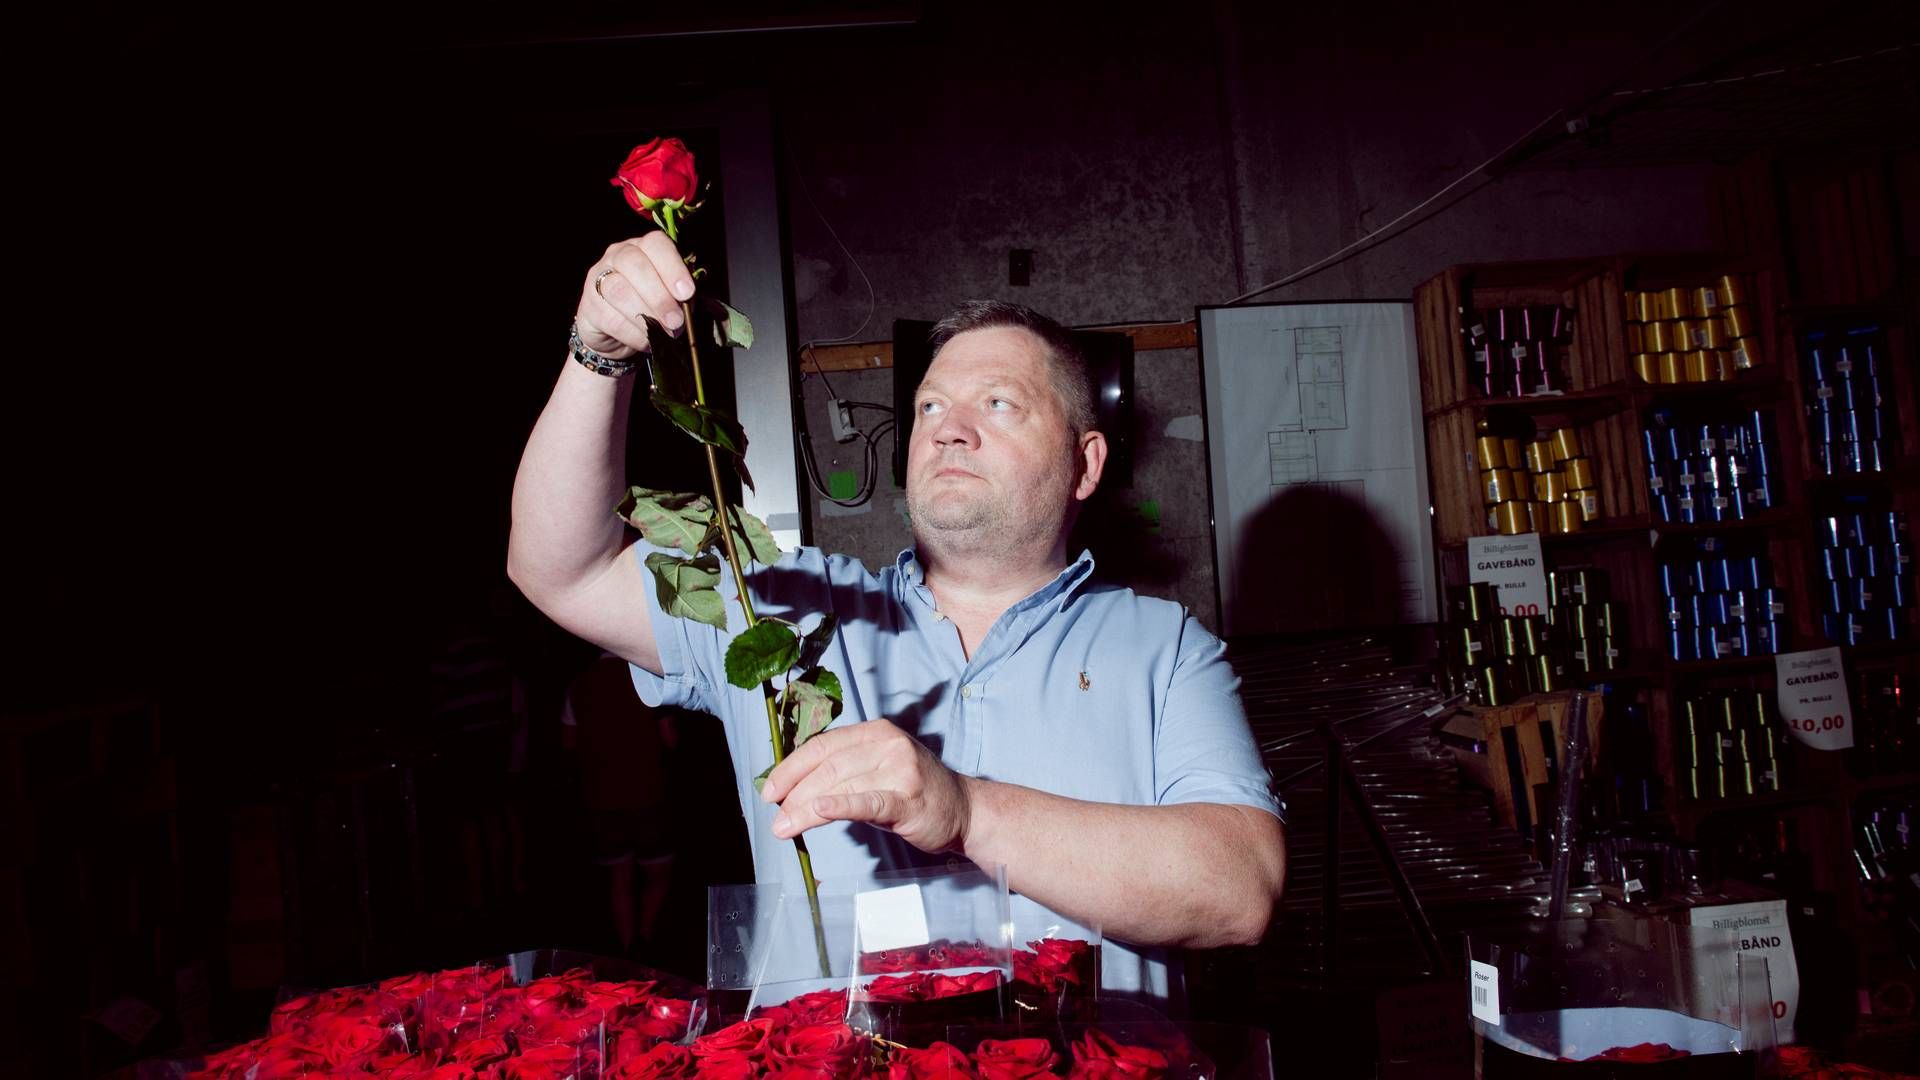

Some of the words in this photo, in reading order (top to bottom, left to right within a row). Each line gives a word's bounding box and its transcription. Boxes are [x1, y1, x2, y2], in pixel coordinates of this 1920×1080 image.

[1477, 557, 1535, 570] GAVEBÅND
[1786, 671, 1839, 686] GAVEBÅND
[1791, 714, 1844, 733] 10,00
[1712, 915, 1770, 930] Billigblomst
[1475, 971, 1489, 982] Roser
